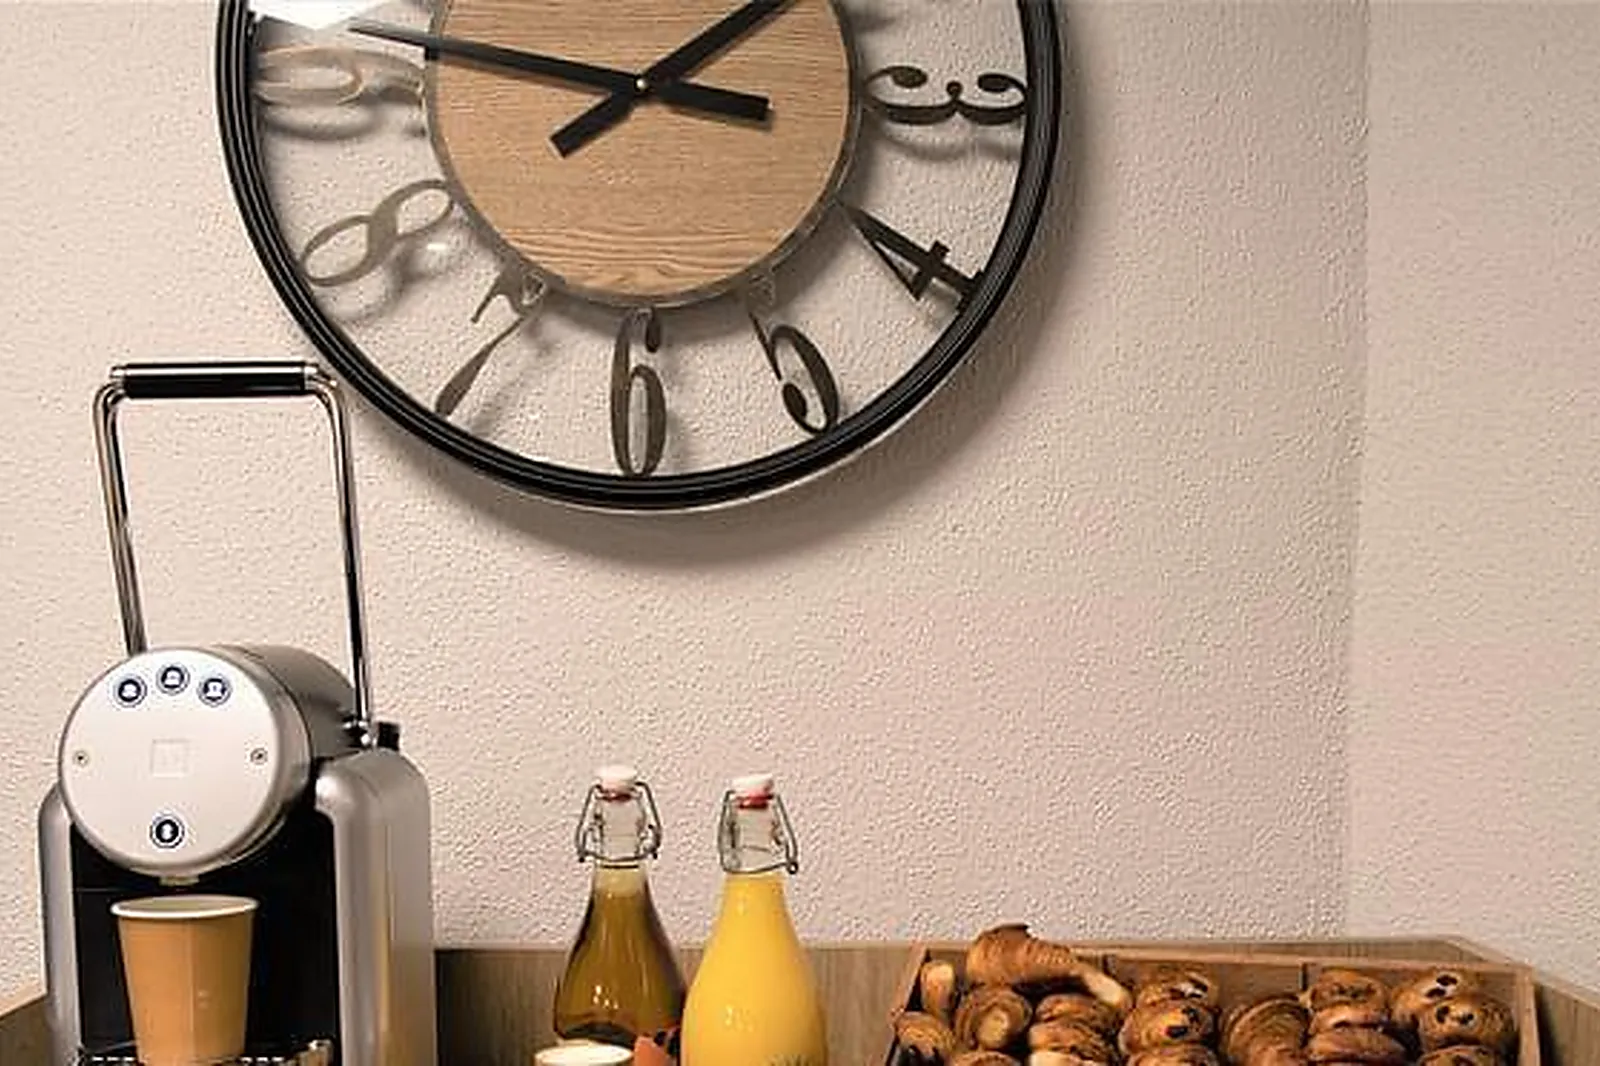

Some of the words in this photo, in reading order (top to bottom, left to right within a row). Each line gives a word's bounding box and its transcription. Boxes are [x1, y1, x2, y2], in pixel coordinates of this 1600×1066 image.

[862, 65, 1027, 125] 3
[302, 178, 454, 287] 8
[838, 202, 983, 310] 4
[435, 256, 546, 417] 7
[610, 306, 667, 478] 6
[747, 280, 840, 435] 5
